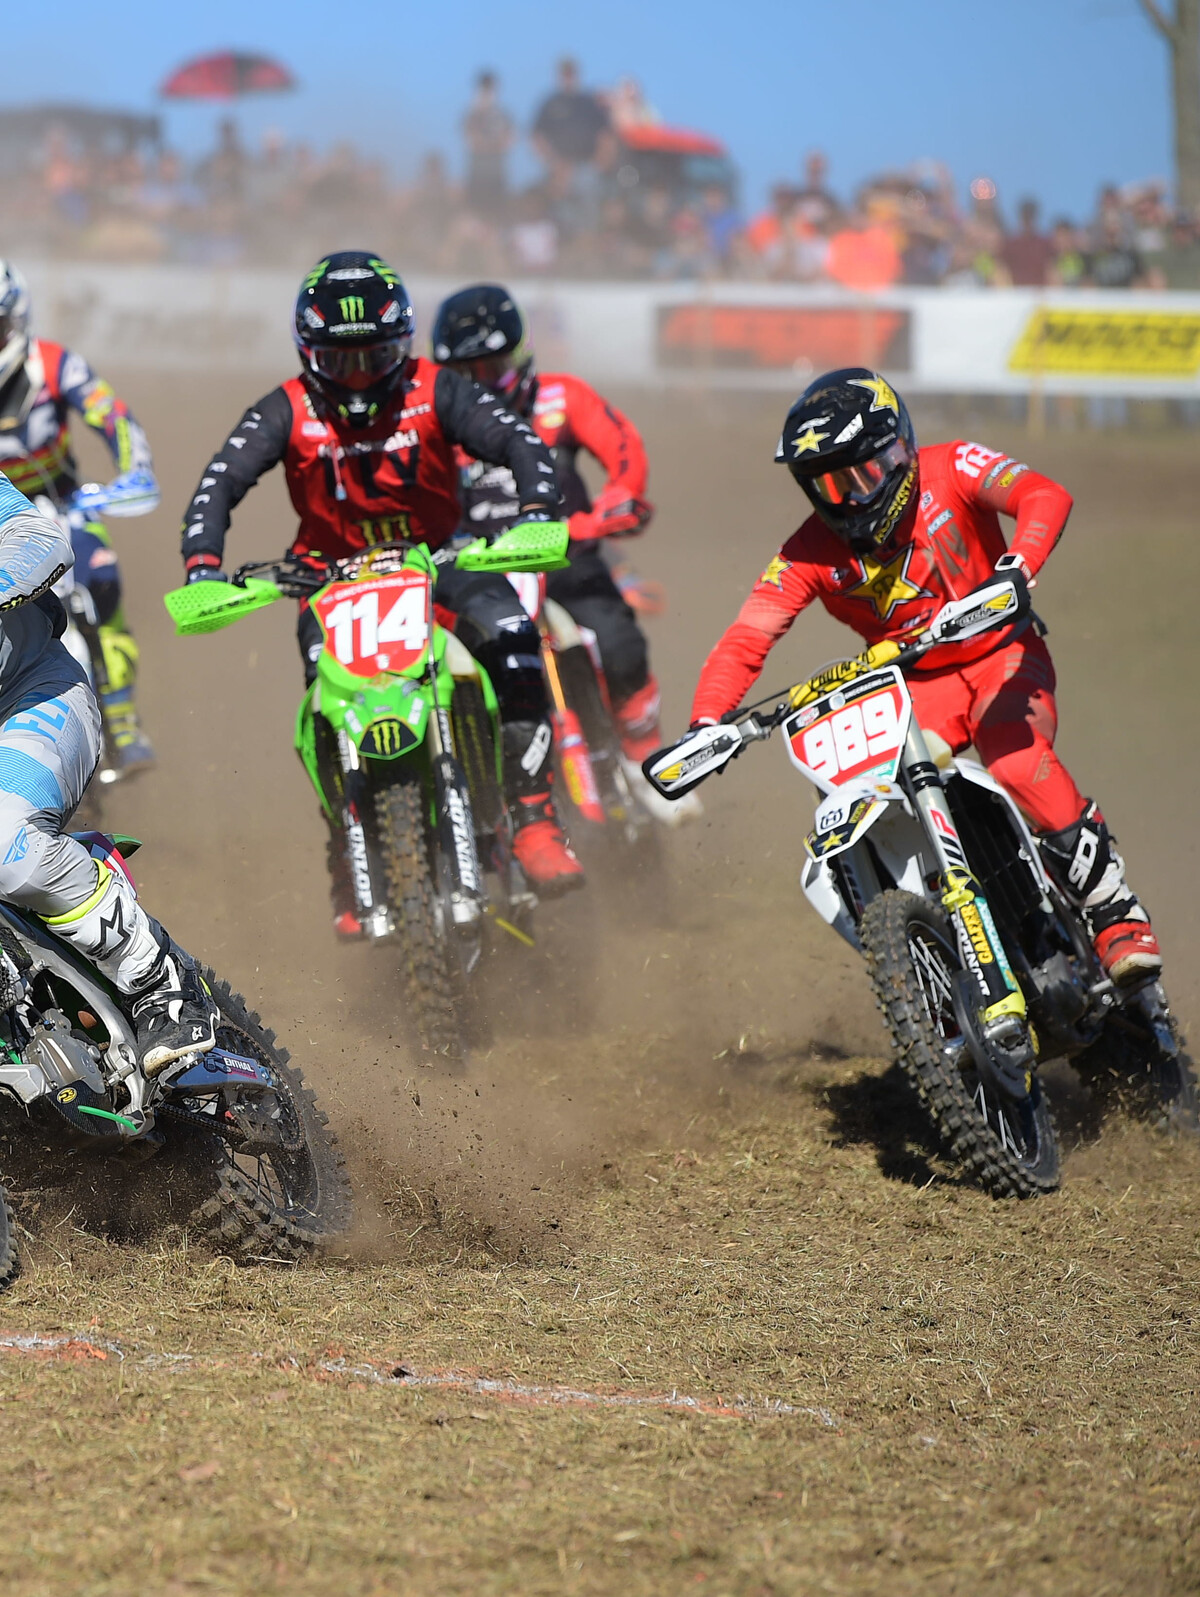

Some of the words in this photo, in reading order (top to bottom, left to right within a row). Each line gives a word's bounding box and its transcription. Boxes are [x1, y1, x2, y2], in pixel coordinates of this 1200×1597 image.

[325, 586, 429, 666] 114
[802, 691, 901, 781] 989
[347, 815, 373, 908] UNLOP
[447, 788, 477, 891] DUNLOP
[960, 903, 995, 964] GALFER
[223, 1057, 255, 1073] ENTHAL
